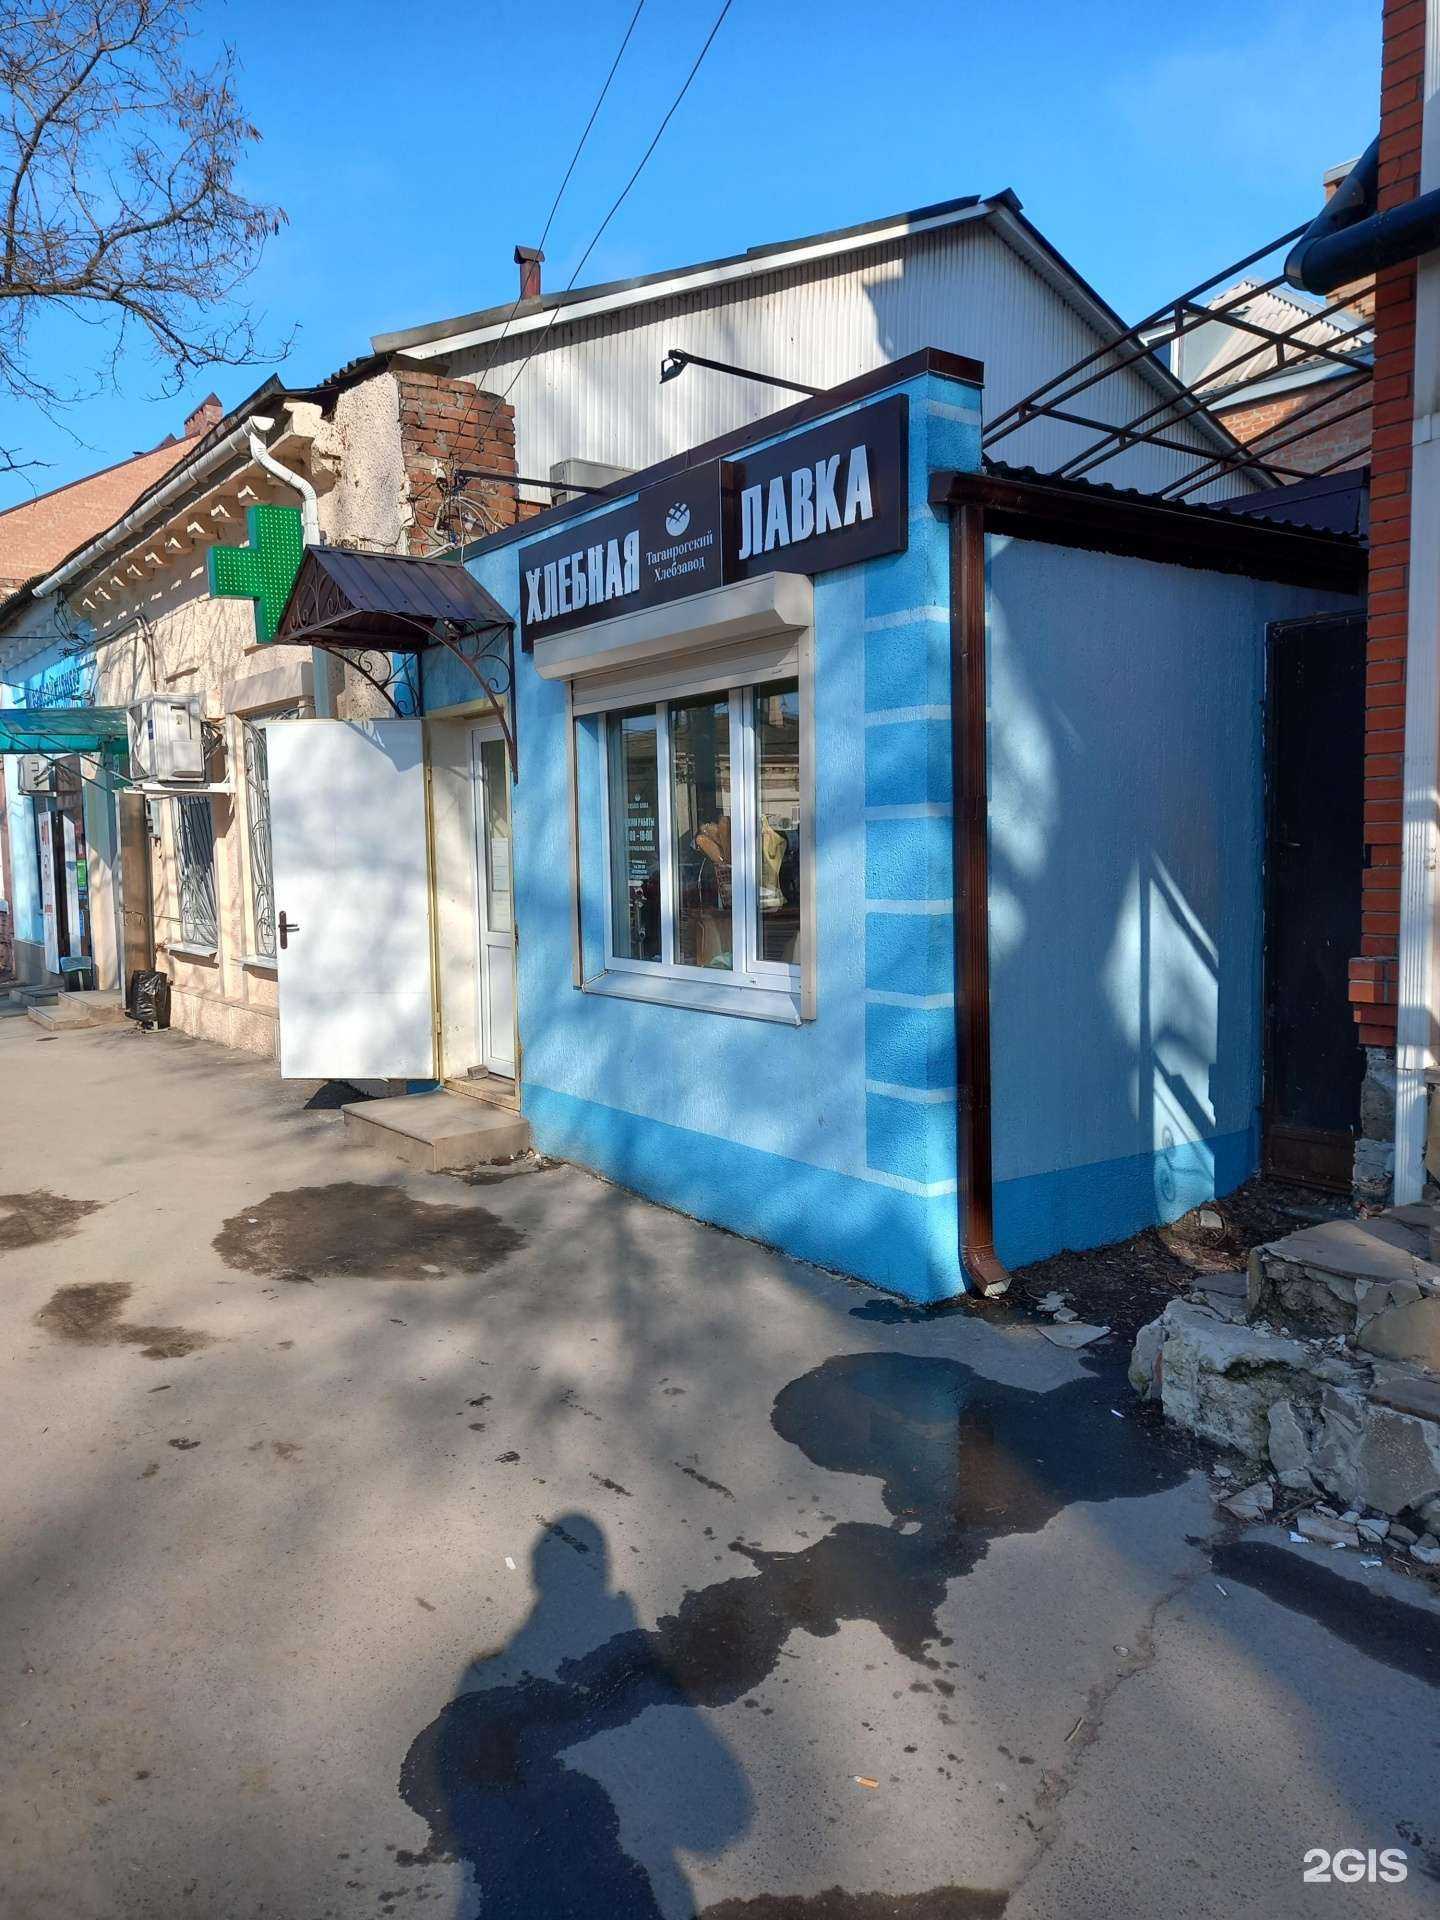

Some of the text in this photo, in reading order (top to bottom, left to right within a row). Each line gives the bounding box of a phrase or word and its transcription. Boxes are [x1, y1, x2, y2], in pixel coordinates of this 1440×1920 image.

[525, 444, 873, 625] ХЛЕБНАЯ ЛАВКА
[645, 529, 713, 565] Таганрогский
[654, 556, 705, 582] Хлебзавод
